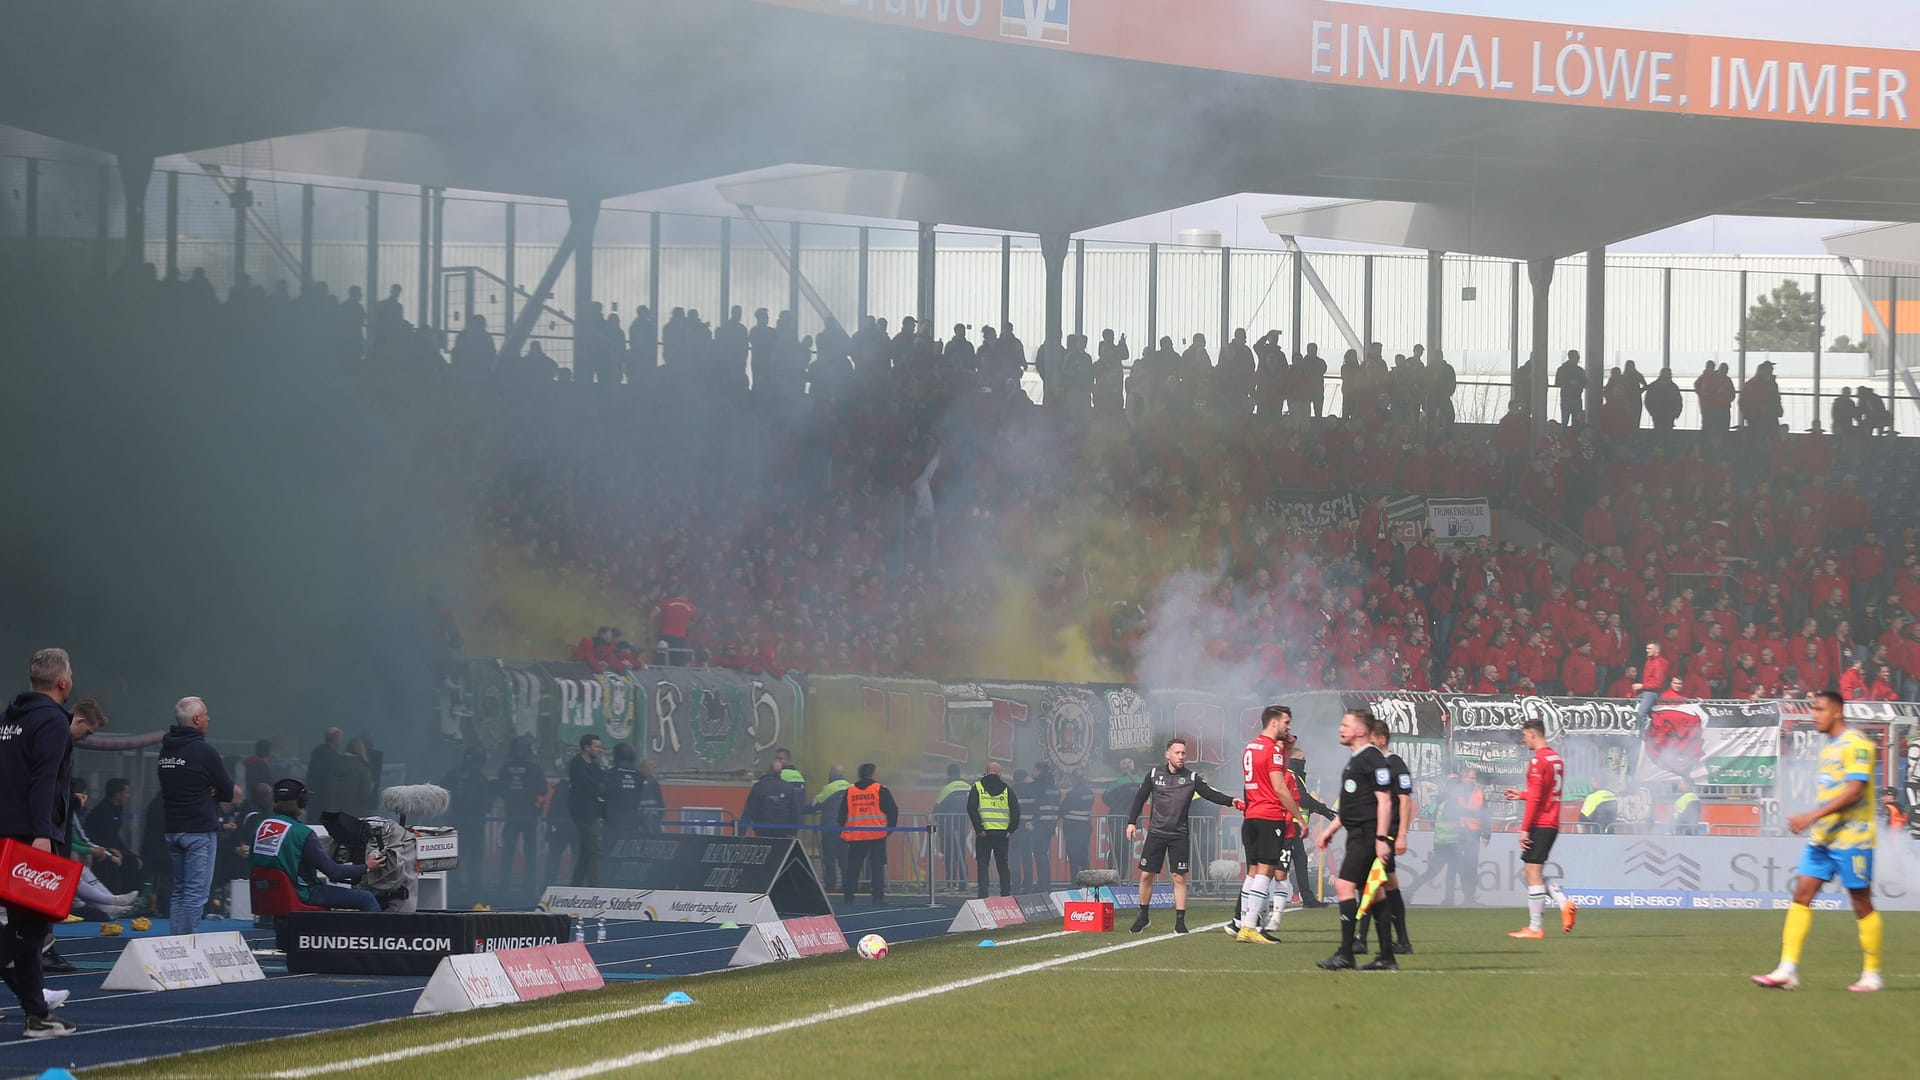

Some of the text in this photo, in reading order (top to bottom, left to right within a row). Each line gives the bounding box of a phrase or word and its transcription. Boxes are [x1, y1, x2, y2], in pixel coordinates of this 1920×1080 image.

[1311, 20, 1513, 91] EINMAL
[1710, 55, 1908, 121] IMMER
[1243, 750, 1253, 782] 9
[1552, 764, 1562, 792] 5
[425, 843, 455, 853] BUNDESLIGA
[606, 896, 643, 911] Stuben
[670, 900, 737, 914] Muttertagsbuffet
[299, 935, 451, 952] BUNDESLIGA.COM
